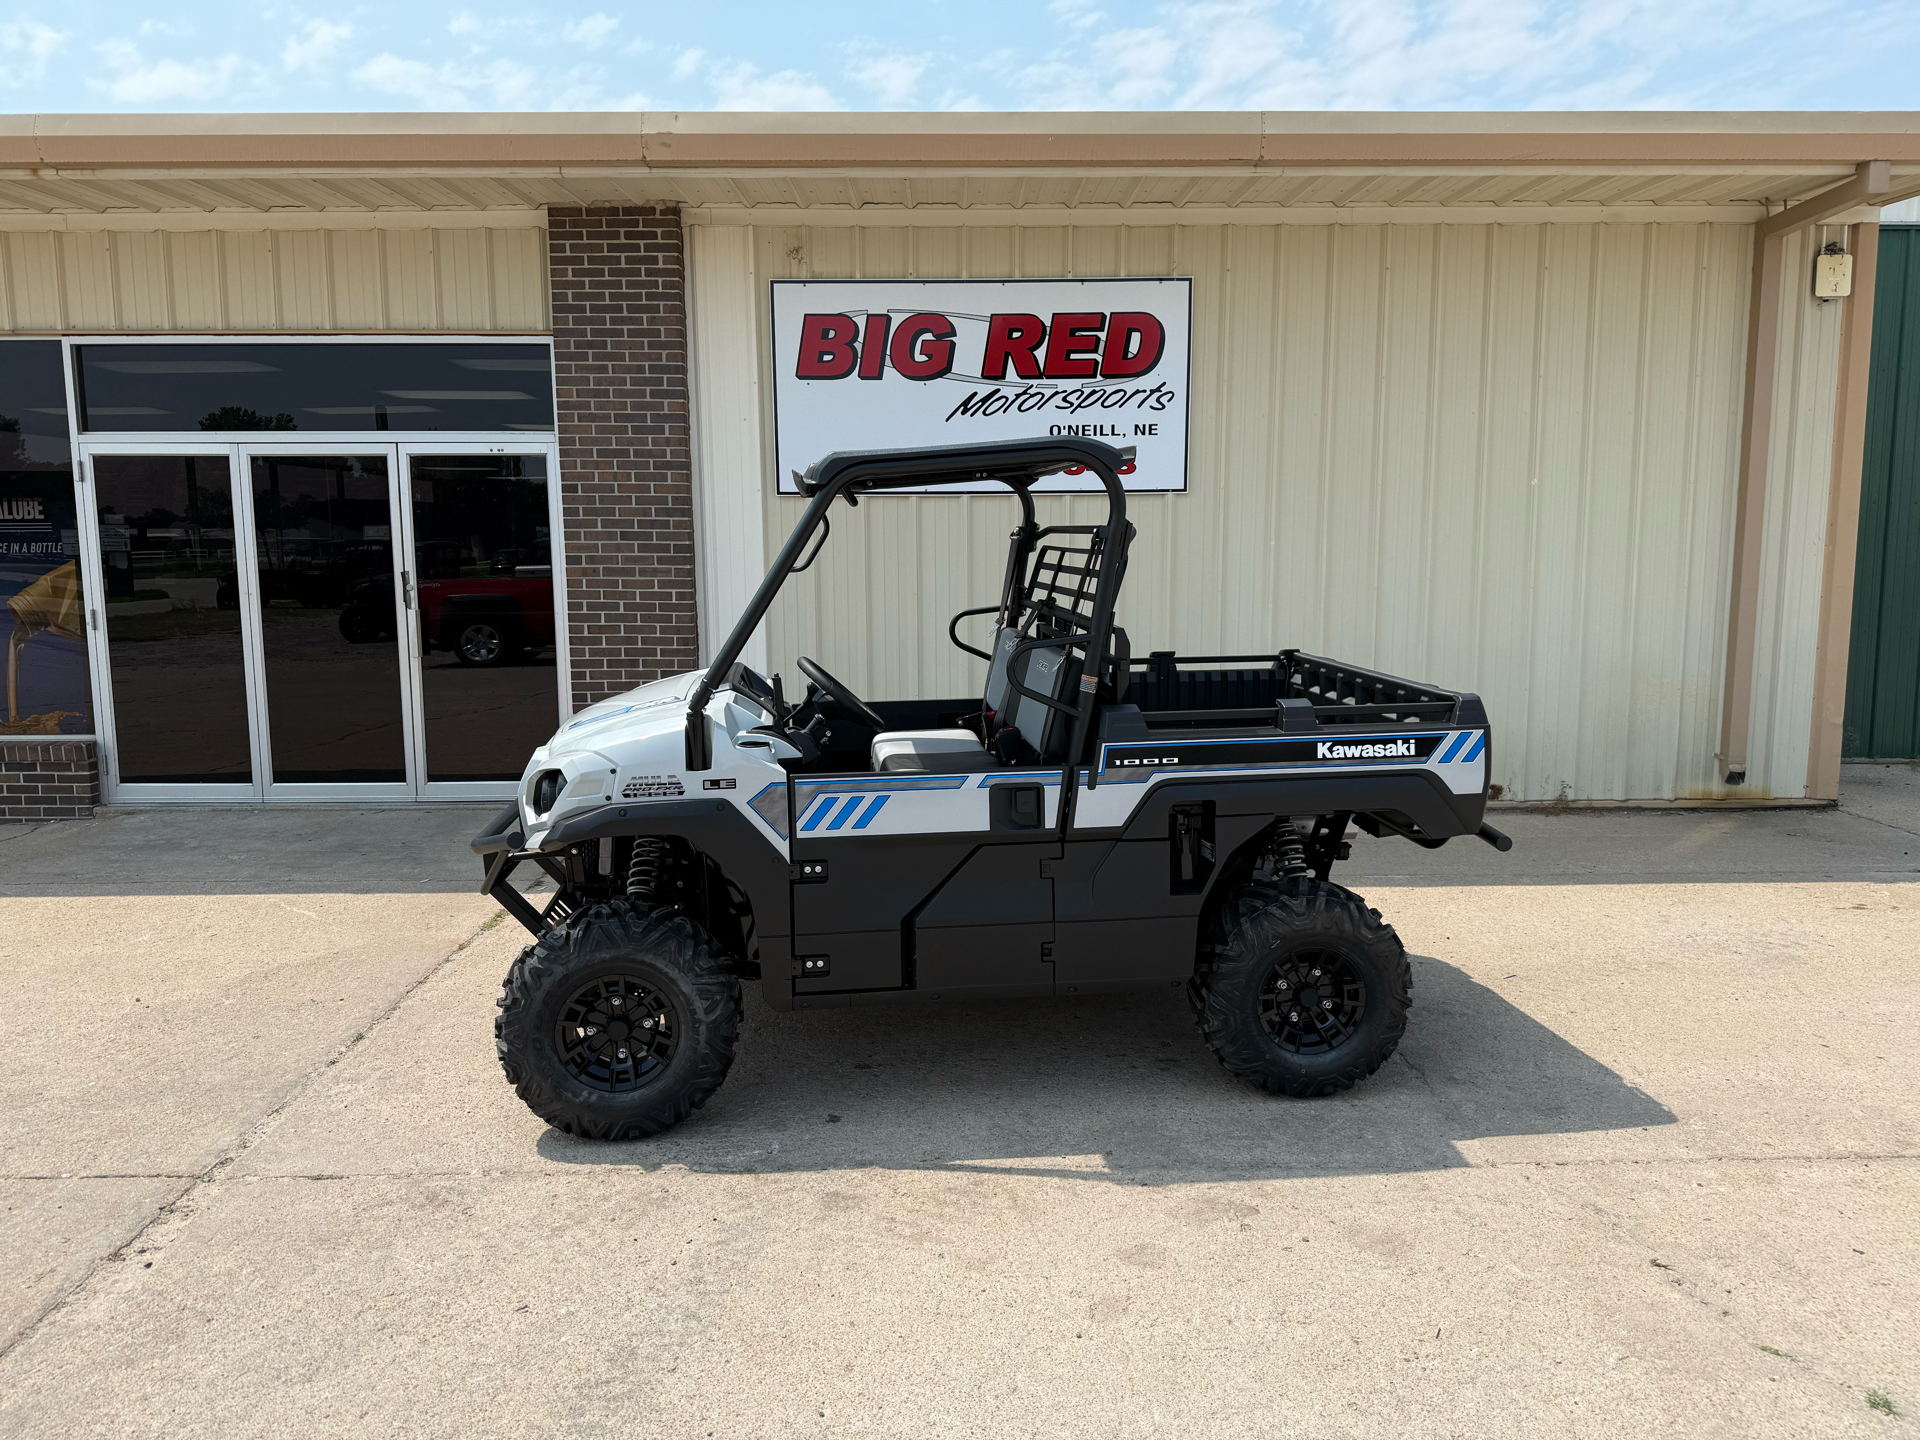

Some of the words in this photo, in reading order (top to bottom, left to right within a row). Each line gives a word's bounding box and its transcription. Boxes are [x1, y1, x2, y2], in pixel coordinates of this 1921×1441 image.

[795, 313, 957, 381] BIG
[981, 311, 1165, 380] RED
[945, 381, 1175, 423] Motorsports
[1049, 423, 1126, 438] O'NEILL,
[1133, 423, 1158, 436] NE
[10, 542, 20, 553] IN
[21, 542, 28, 553] A
[30, 542, 63, 553] BOTTLE
[1317, 739, 1415, 759] Kawasaki
[1114, 757, 1178, 766] 1000
[625, 775, 682, 787] MULE
[704, 778, 736, 789] LE
